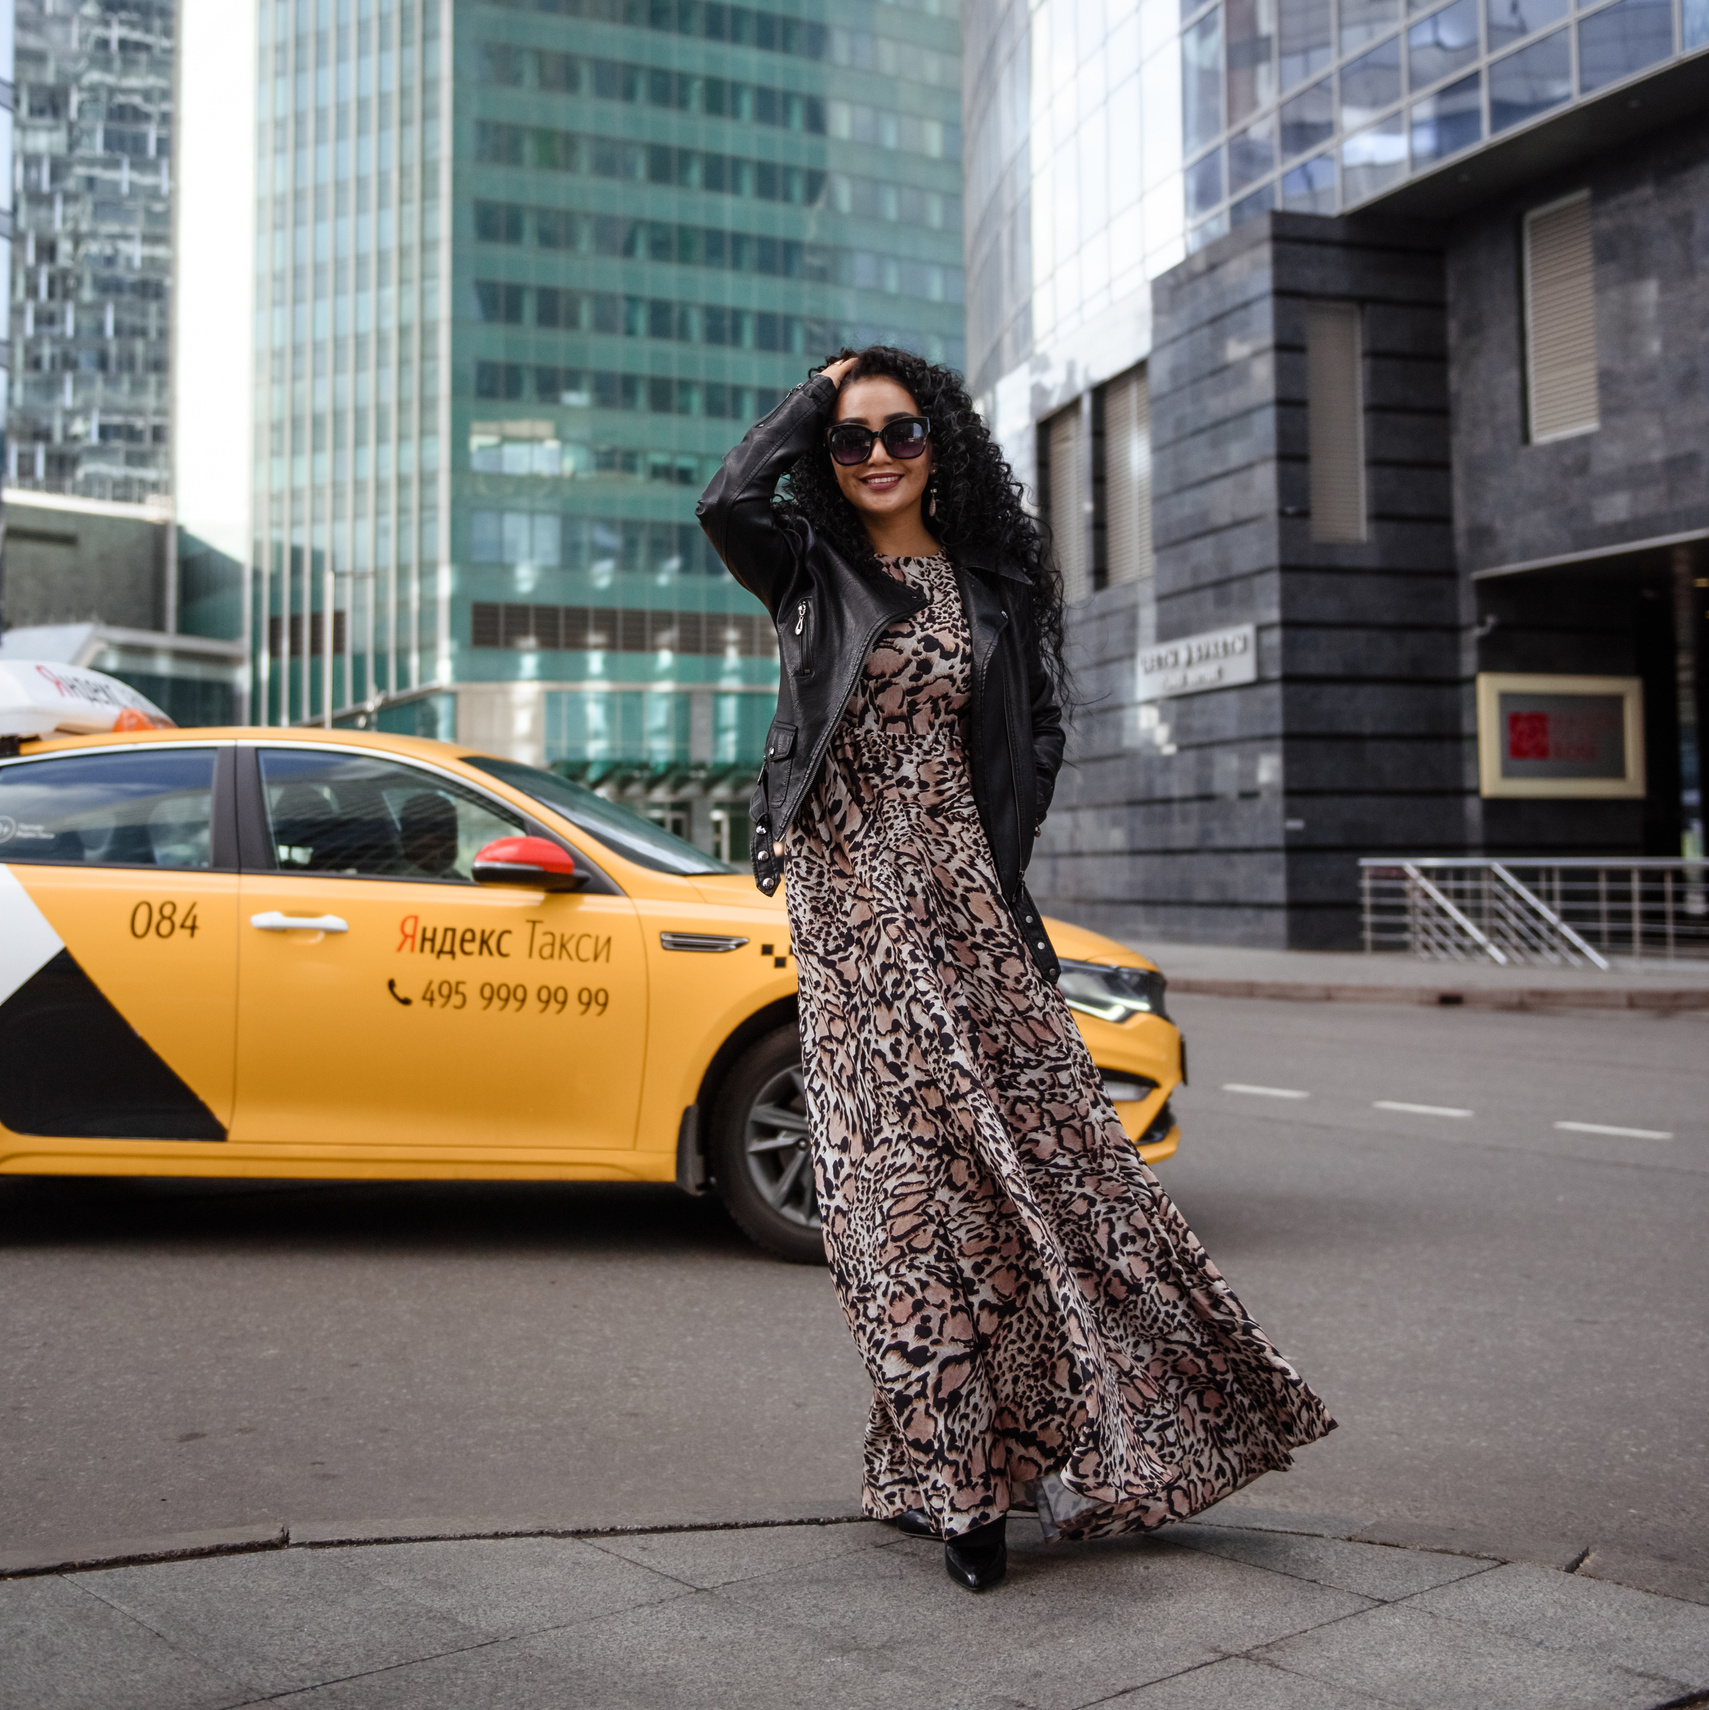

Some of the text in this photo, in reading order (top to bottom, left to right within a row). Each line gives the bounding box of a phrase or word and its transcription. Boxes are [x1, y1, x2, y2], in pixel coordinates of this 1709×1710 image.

[130, 900, 199, 939] 084
[396, 915, 612, 963] Яндекс Такси
[421, 979, 610, 1017] 495 999 99 99
